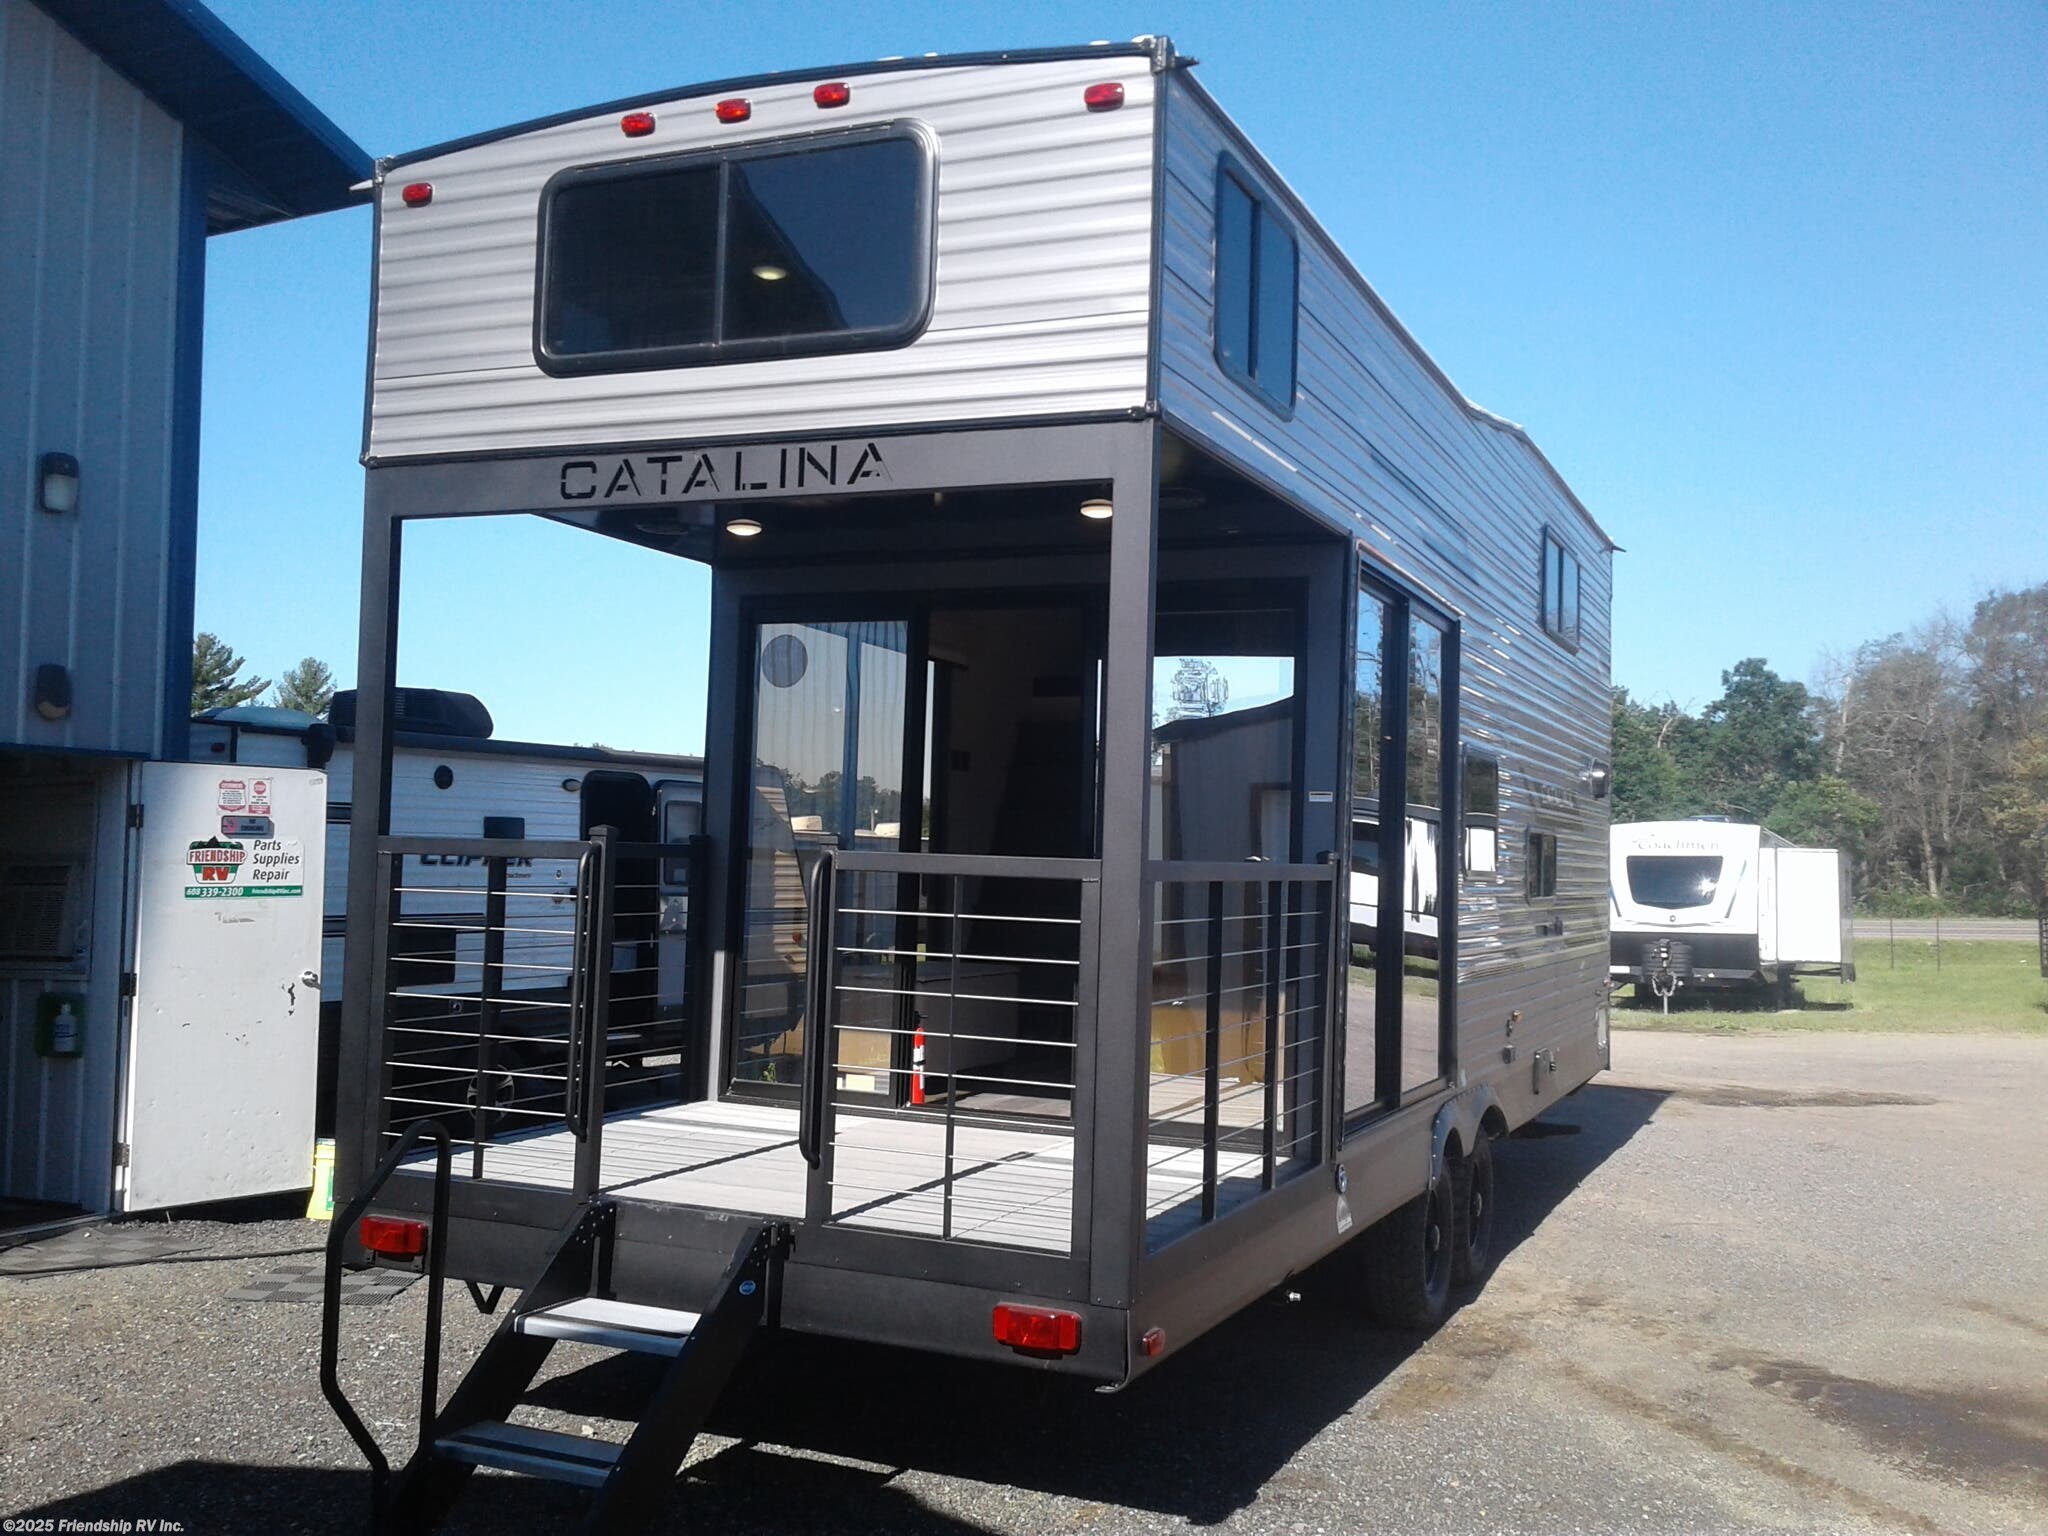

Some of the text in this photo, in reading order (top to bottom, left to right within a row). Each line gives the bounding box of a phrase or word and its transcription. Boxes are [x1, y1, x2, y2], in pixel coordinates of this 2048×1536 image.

[560, 442, 893, 500] CATALINA
[253, 839, 282, 851] Parts
[189, 850, 246, 863] FRIENDSHIP
[252, 853, 300, 867] Supplies
[202, 866, 231, 881] RV
[252, 868, 290, 883] Repair
[200, 886, 244, 897] 339-2300
